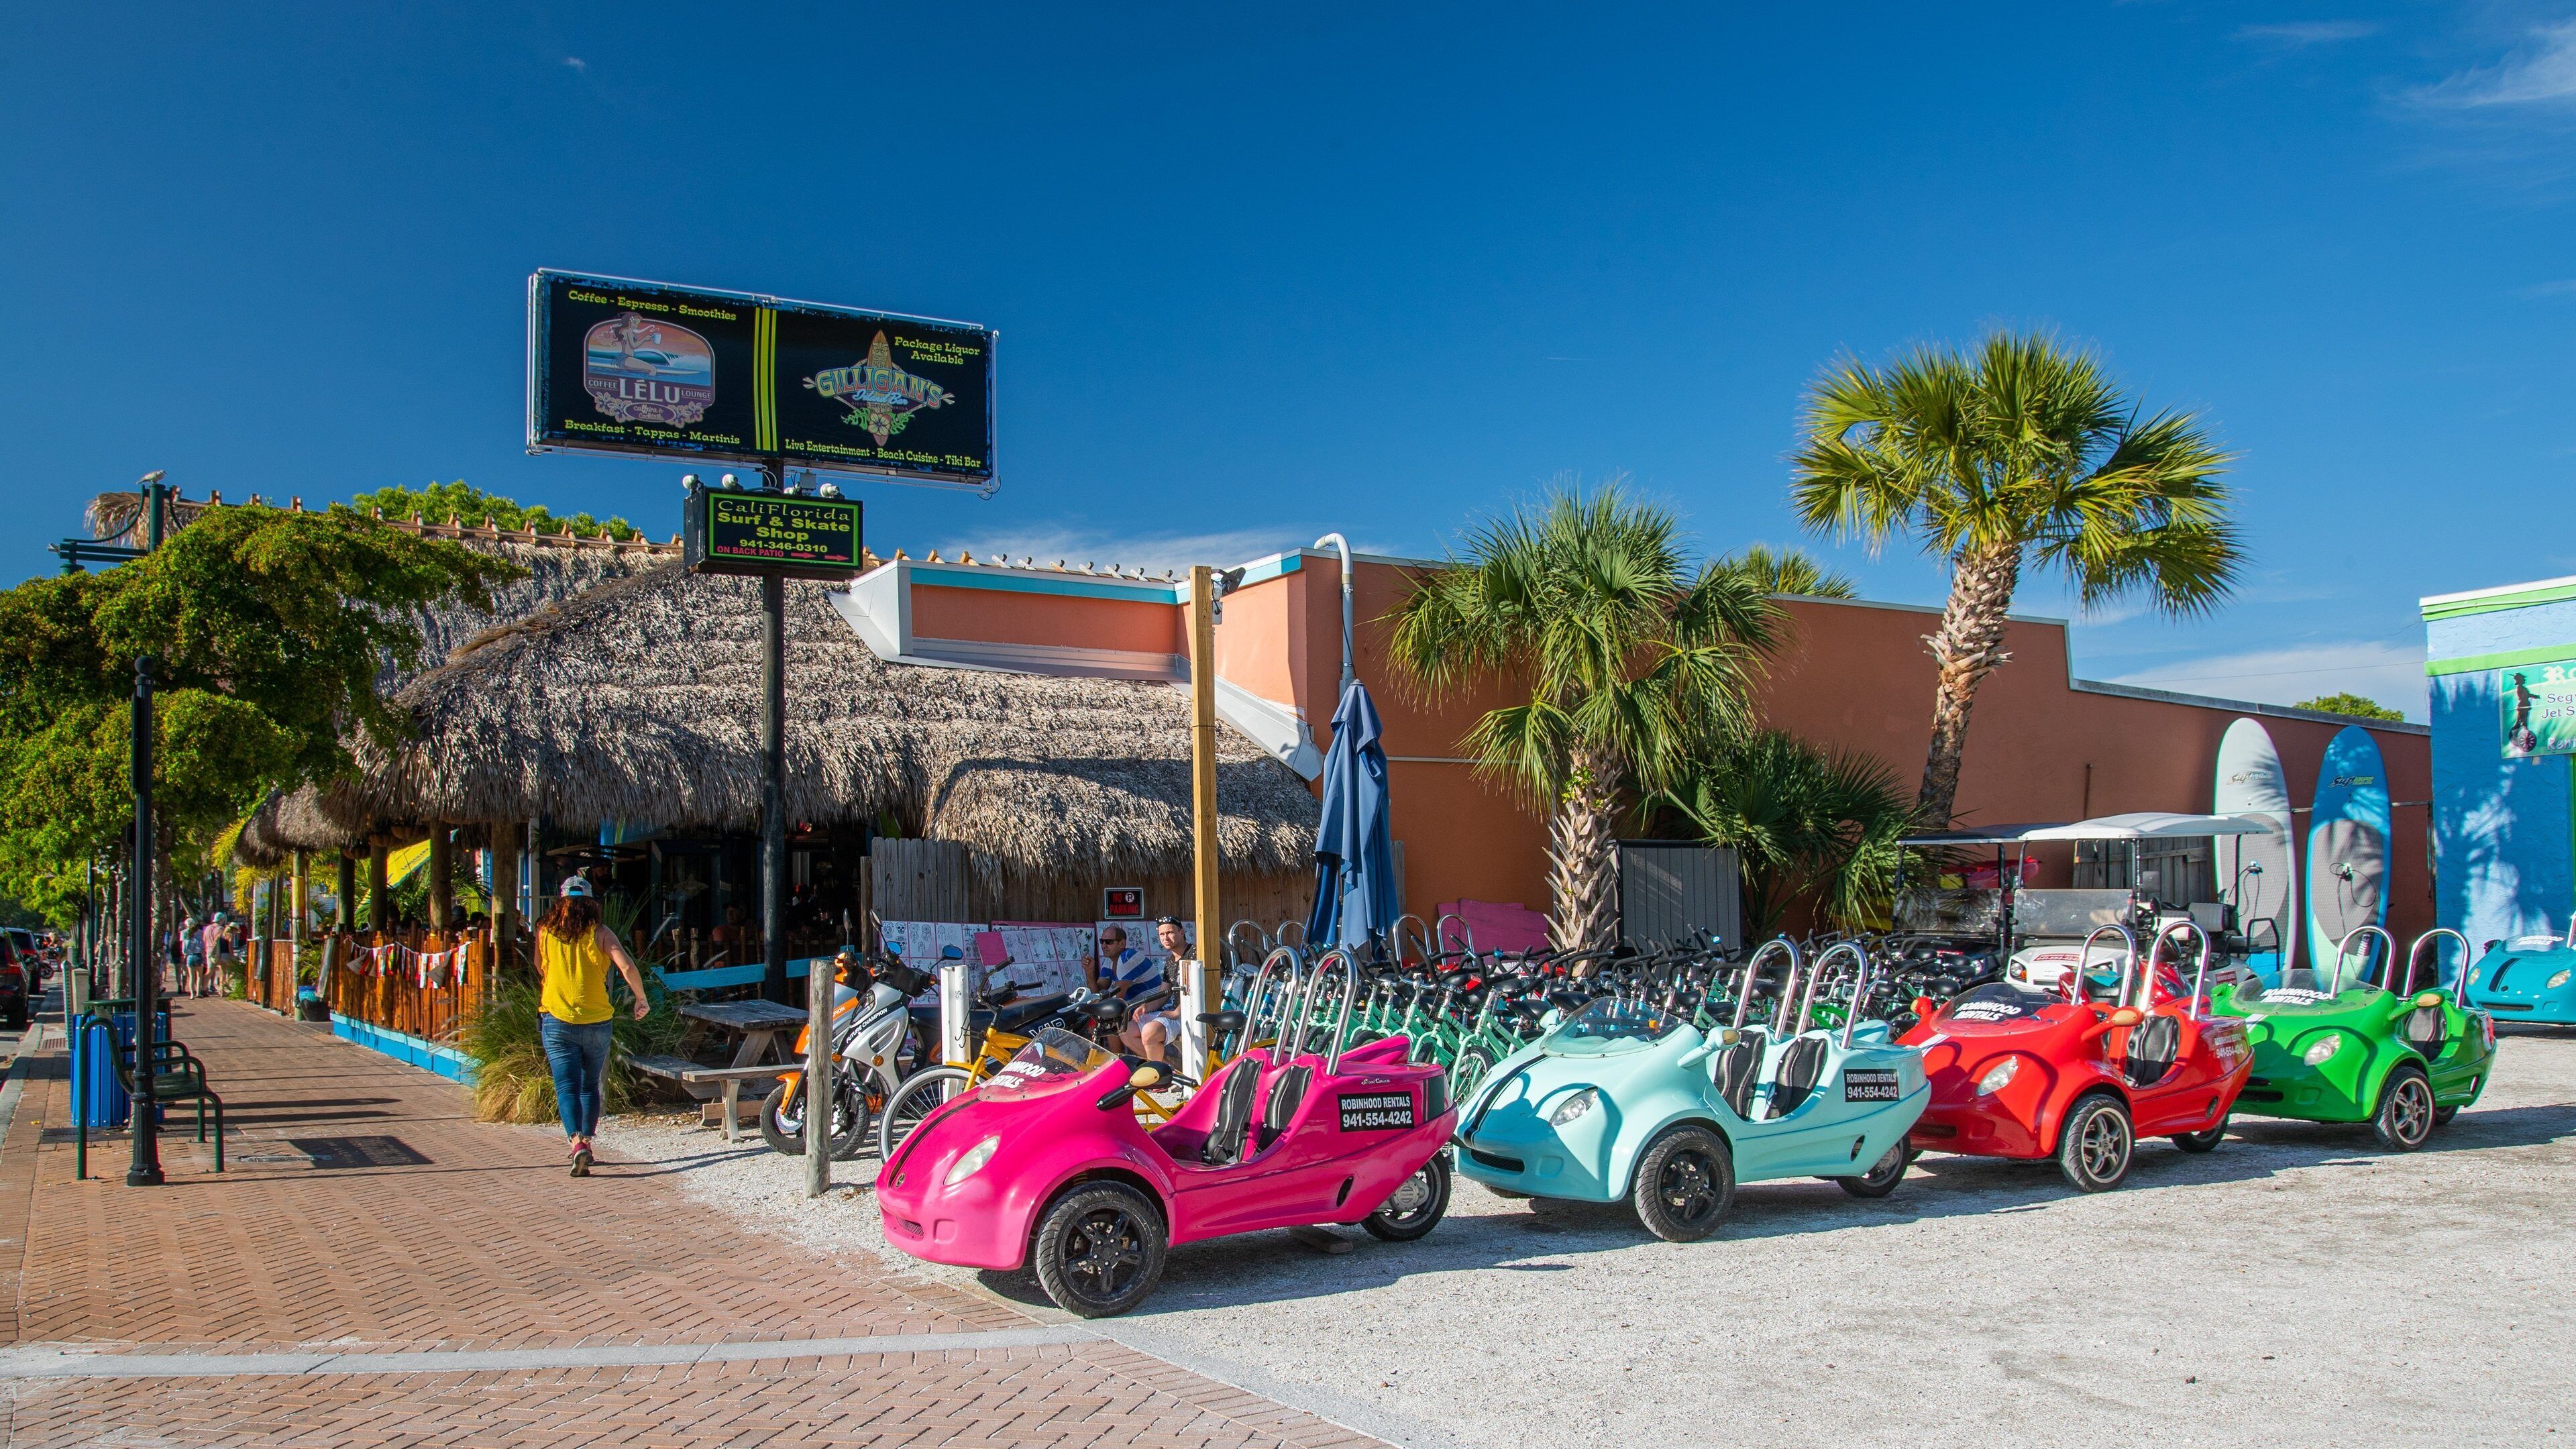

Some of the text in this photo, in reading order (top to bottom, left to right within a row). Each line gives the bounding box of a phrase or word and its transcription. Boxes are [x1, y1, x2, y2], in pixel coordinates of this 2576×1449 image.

[568, 290, 607, 304] Coffee
[617, 297, 669, 312] Espresso
[679, 305, 737, 321] Smoothies
[894, 336, 980, 356] Package Liquor
[911, 351, 964, 365] Available
[588, 379, 618, 389] COFFEE
[681, 390, 712, 399] LOUNGE
[815, 367, 943, 409] GILLIGAN'S
[852, 388, 909, 405] Island Bar
[565, 419, 625, 434] Breakfast
[635, 426, 680, 439] Tappas
[689, 431, 741, 444] Martinis
[785, 438, 805, 451] Live
[806, 441, 871, 458] Entertainment
[877, 447, 905, 460] Beach
[906, 450, 938, 464] Cuisine
[945, 454, 963, 466] Tiki
[964, 456, 981, 468] Bar
[718, 500, 851, 521] CaliFlorida
[718, 512, 851, 532] Surf & Skate
[756, 527, 809, 543] Shop
[716, 545, 784, 557] ON BACK PATIO
[740, 539, 828, 553] 941-346-0310
[2547, 693, 2576, 704] Seg
[2541, 708, 2562, 718] Jet
[1113, 893, 1123, 902] NO
[1109, 904, 1138, 914] PARKING
[1952, 1010, 2004, 1021] RENTALS
[1955, 1002, 2022, 1015] ROBINHOOD
[846, 1008, 888, 1044] FUTURE CHAMPION
[1846, 1073, 1897, 1083] ROBINHOOD RENTALS
[1847, 1085, 1898, 1098] 941-554-4242
[1341, 1096, 1410, 1110] ROBINHOOD RENTALS
[1342, 1110, 1412, 1128] 941-554-4242
